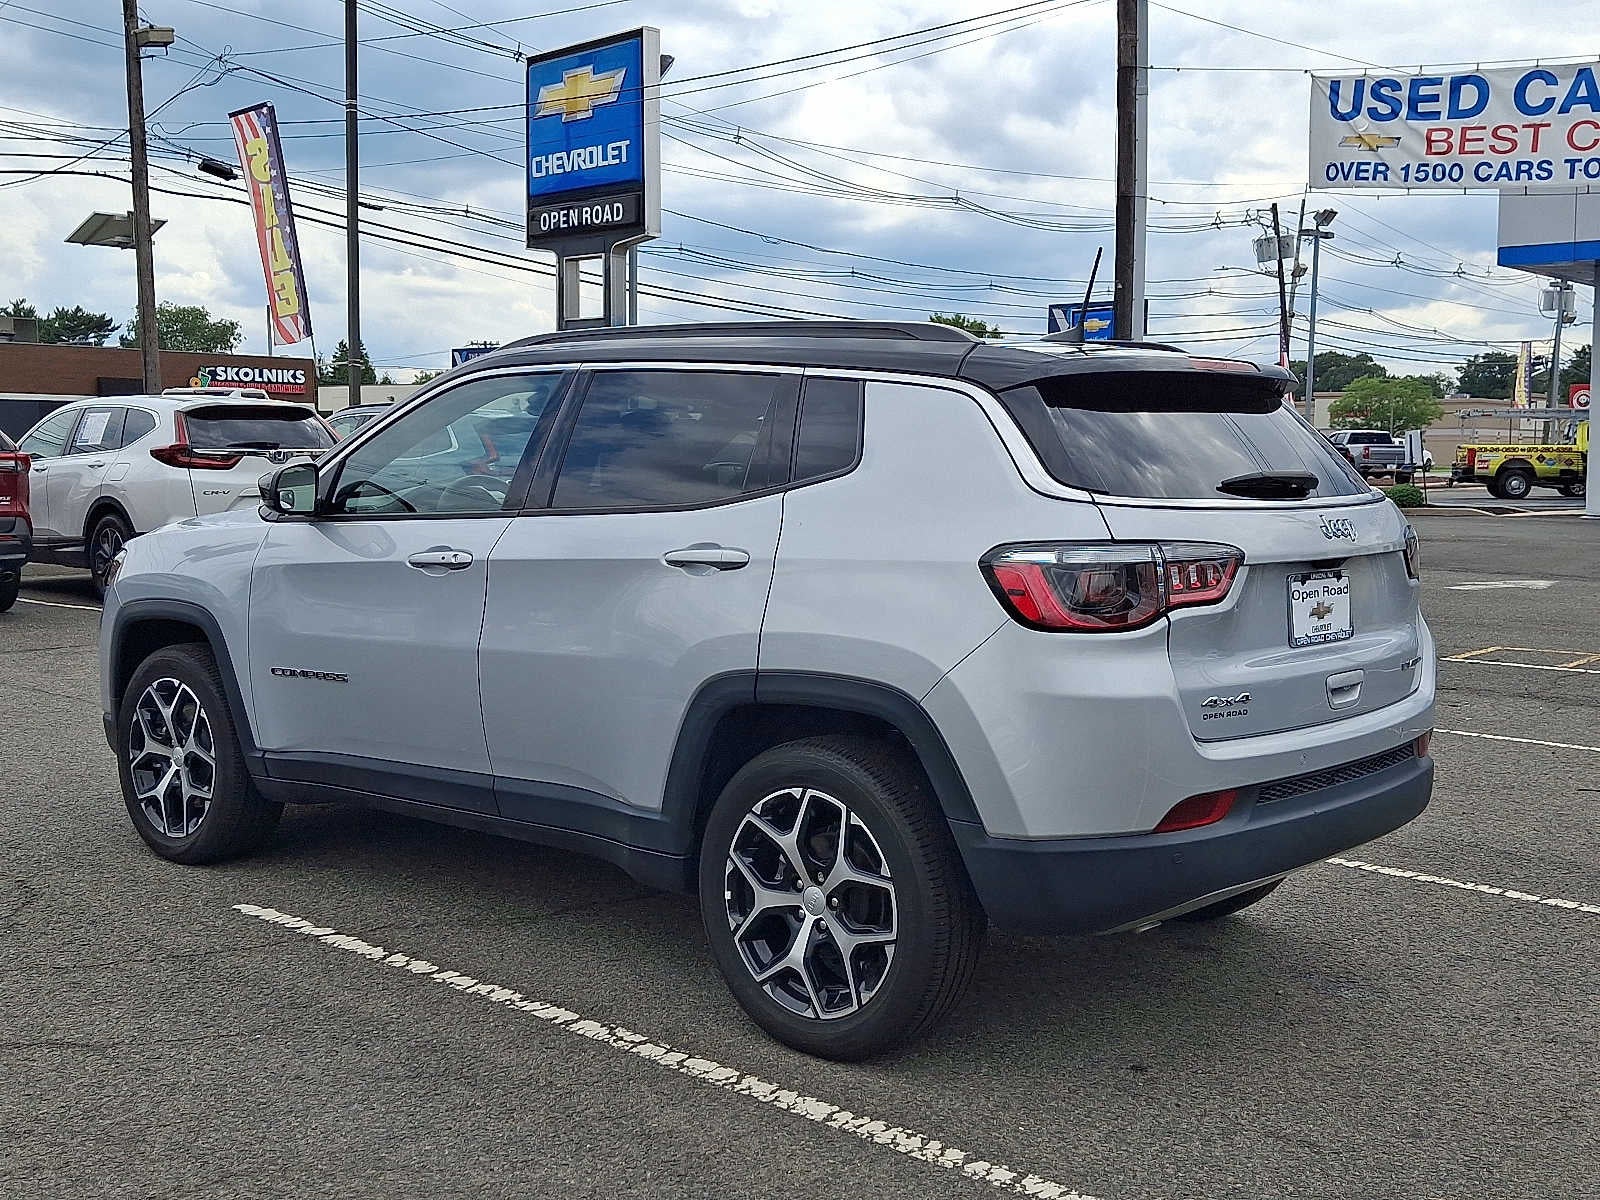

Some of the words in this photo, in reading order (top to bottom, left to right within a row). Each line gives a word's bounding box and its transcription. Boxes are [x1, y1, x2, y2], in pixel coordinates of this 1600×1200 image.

[1328, 76, 1490, 122] USED
[1513, 67, 1600, 116] CA
[1424, 122, 1551, 155] BEST
[532, 140, 630, 178] CHEVROLET
[1325, 161, 1390, 183] OVER
[1400, 162, 1464, 183] 1500
[1473, 158, 1553, 182] CARS
[1563, 156, 1600, 180] TO
[540, 208, 578, 231] OPEN
[582, 202, 623, 225] ROAD
[215, 366, 306, 384] SKOLNIKS
[1318, 514, 1357, 542] Jeep
[1292, 589, 1320, 602] Open
[1322, 583, 1349, 596] Road
[271, 667, 349, 682] COMPASS
[1201, 692, 1252, 707] 4x4
[1202, 711, 1225, 721] OPEN
[1226, 708, 1248, 718] ROAD
